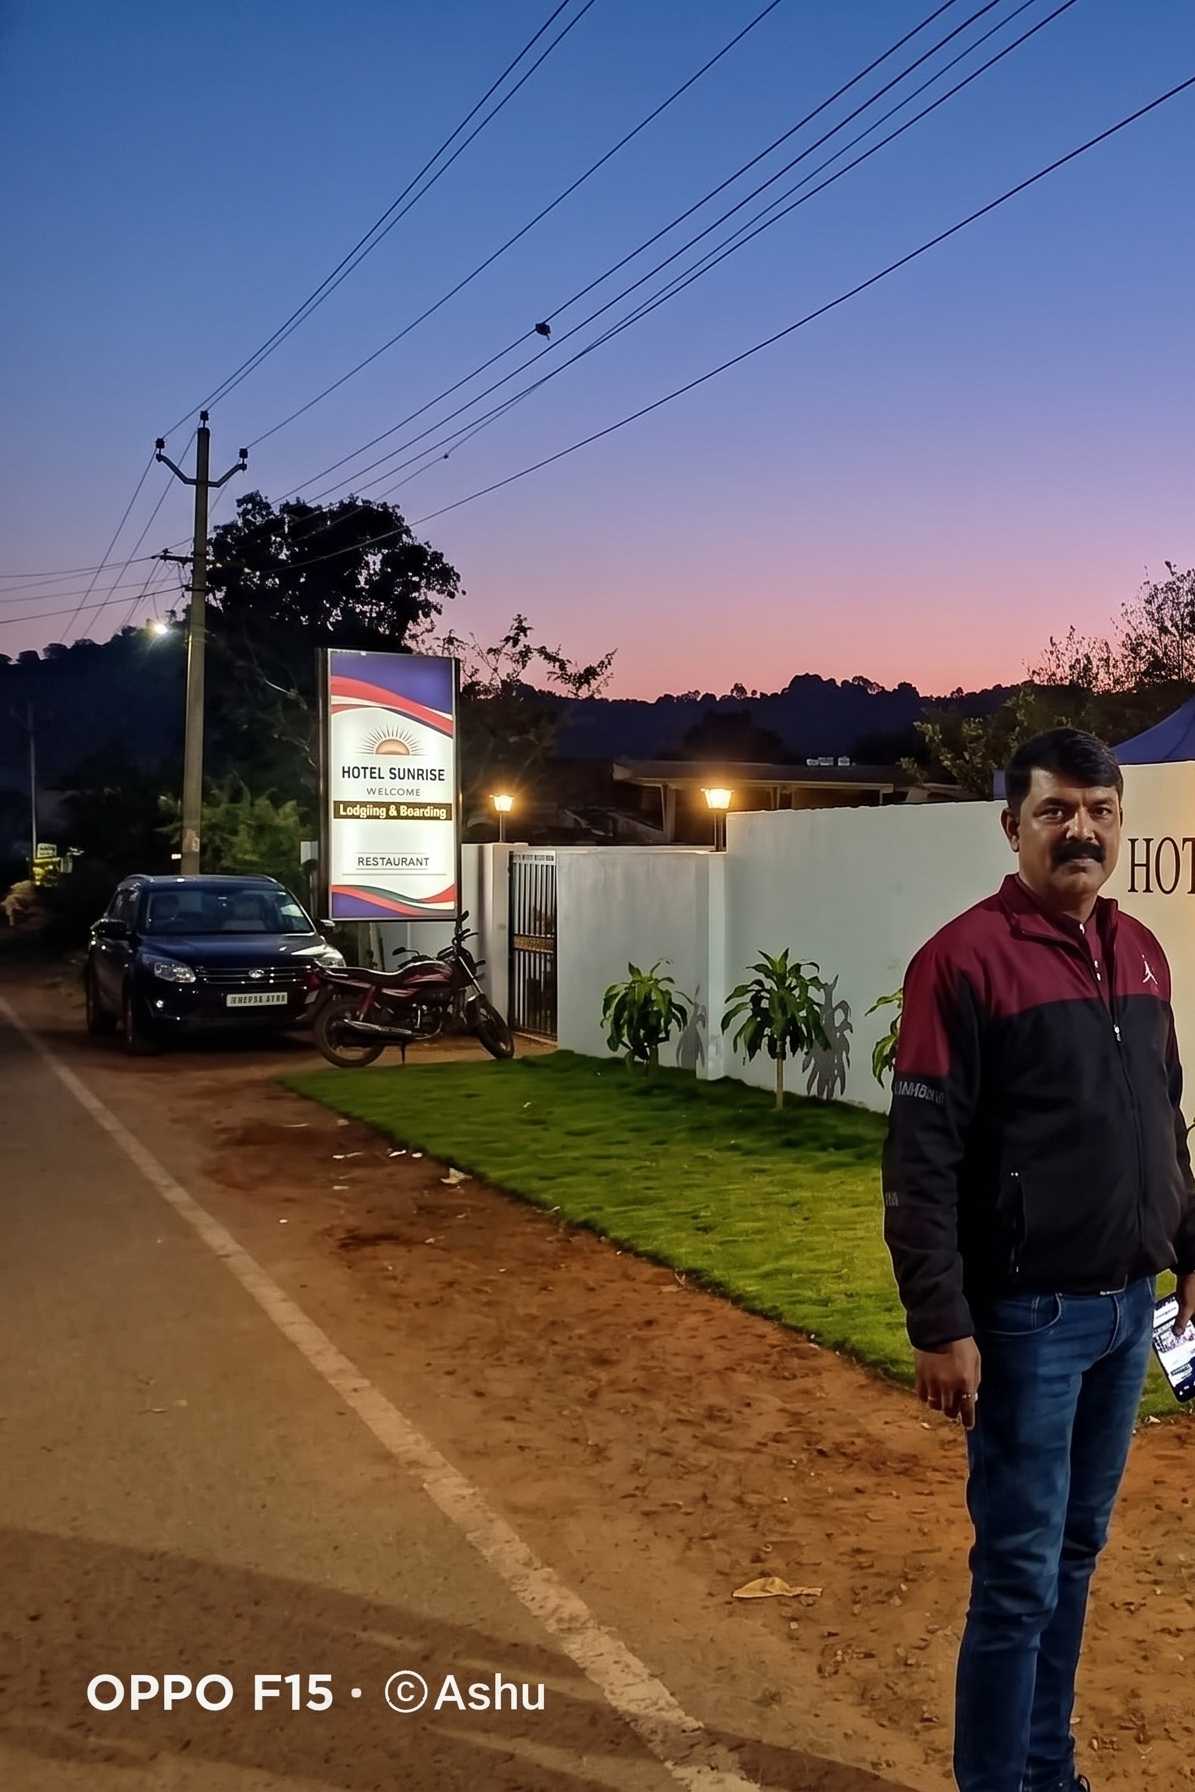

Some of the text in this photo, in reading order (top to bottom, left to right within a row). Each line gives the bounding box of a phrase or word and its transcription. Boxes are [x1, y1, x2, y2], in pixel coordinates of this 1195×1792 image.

[341, 766, 446, 781] HOTEL SUNRISE
[366, 787, 421, 796] WELCOME
[388, 804, 398, 817] &
[357, 856, 430, 867] RESTAURANT
